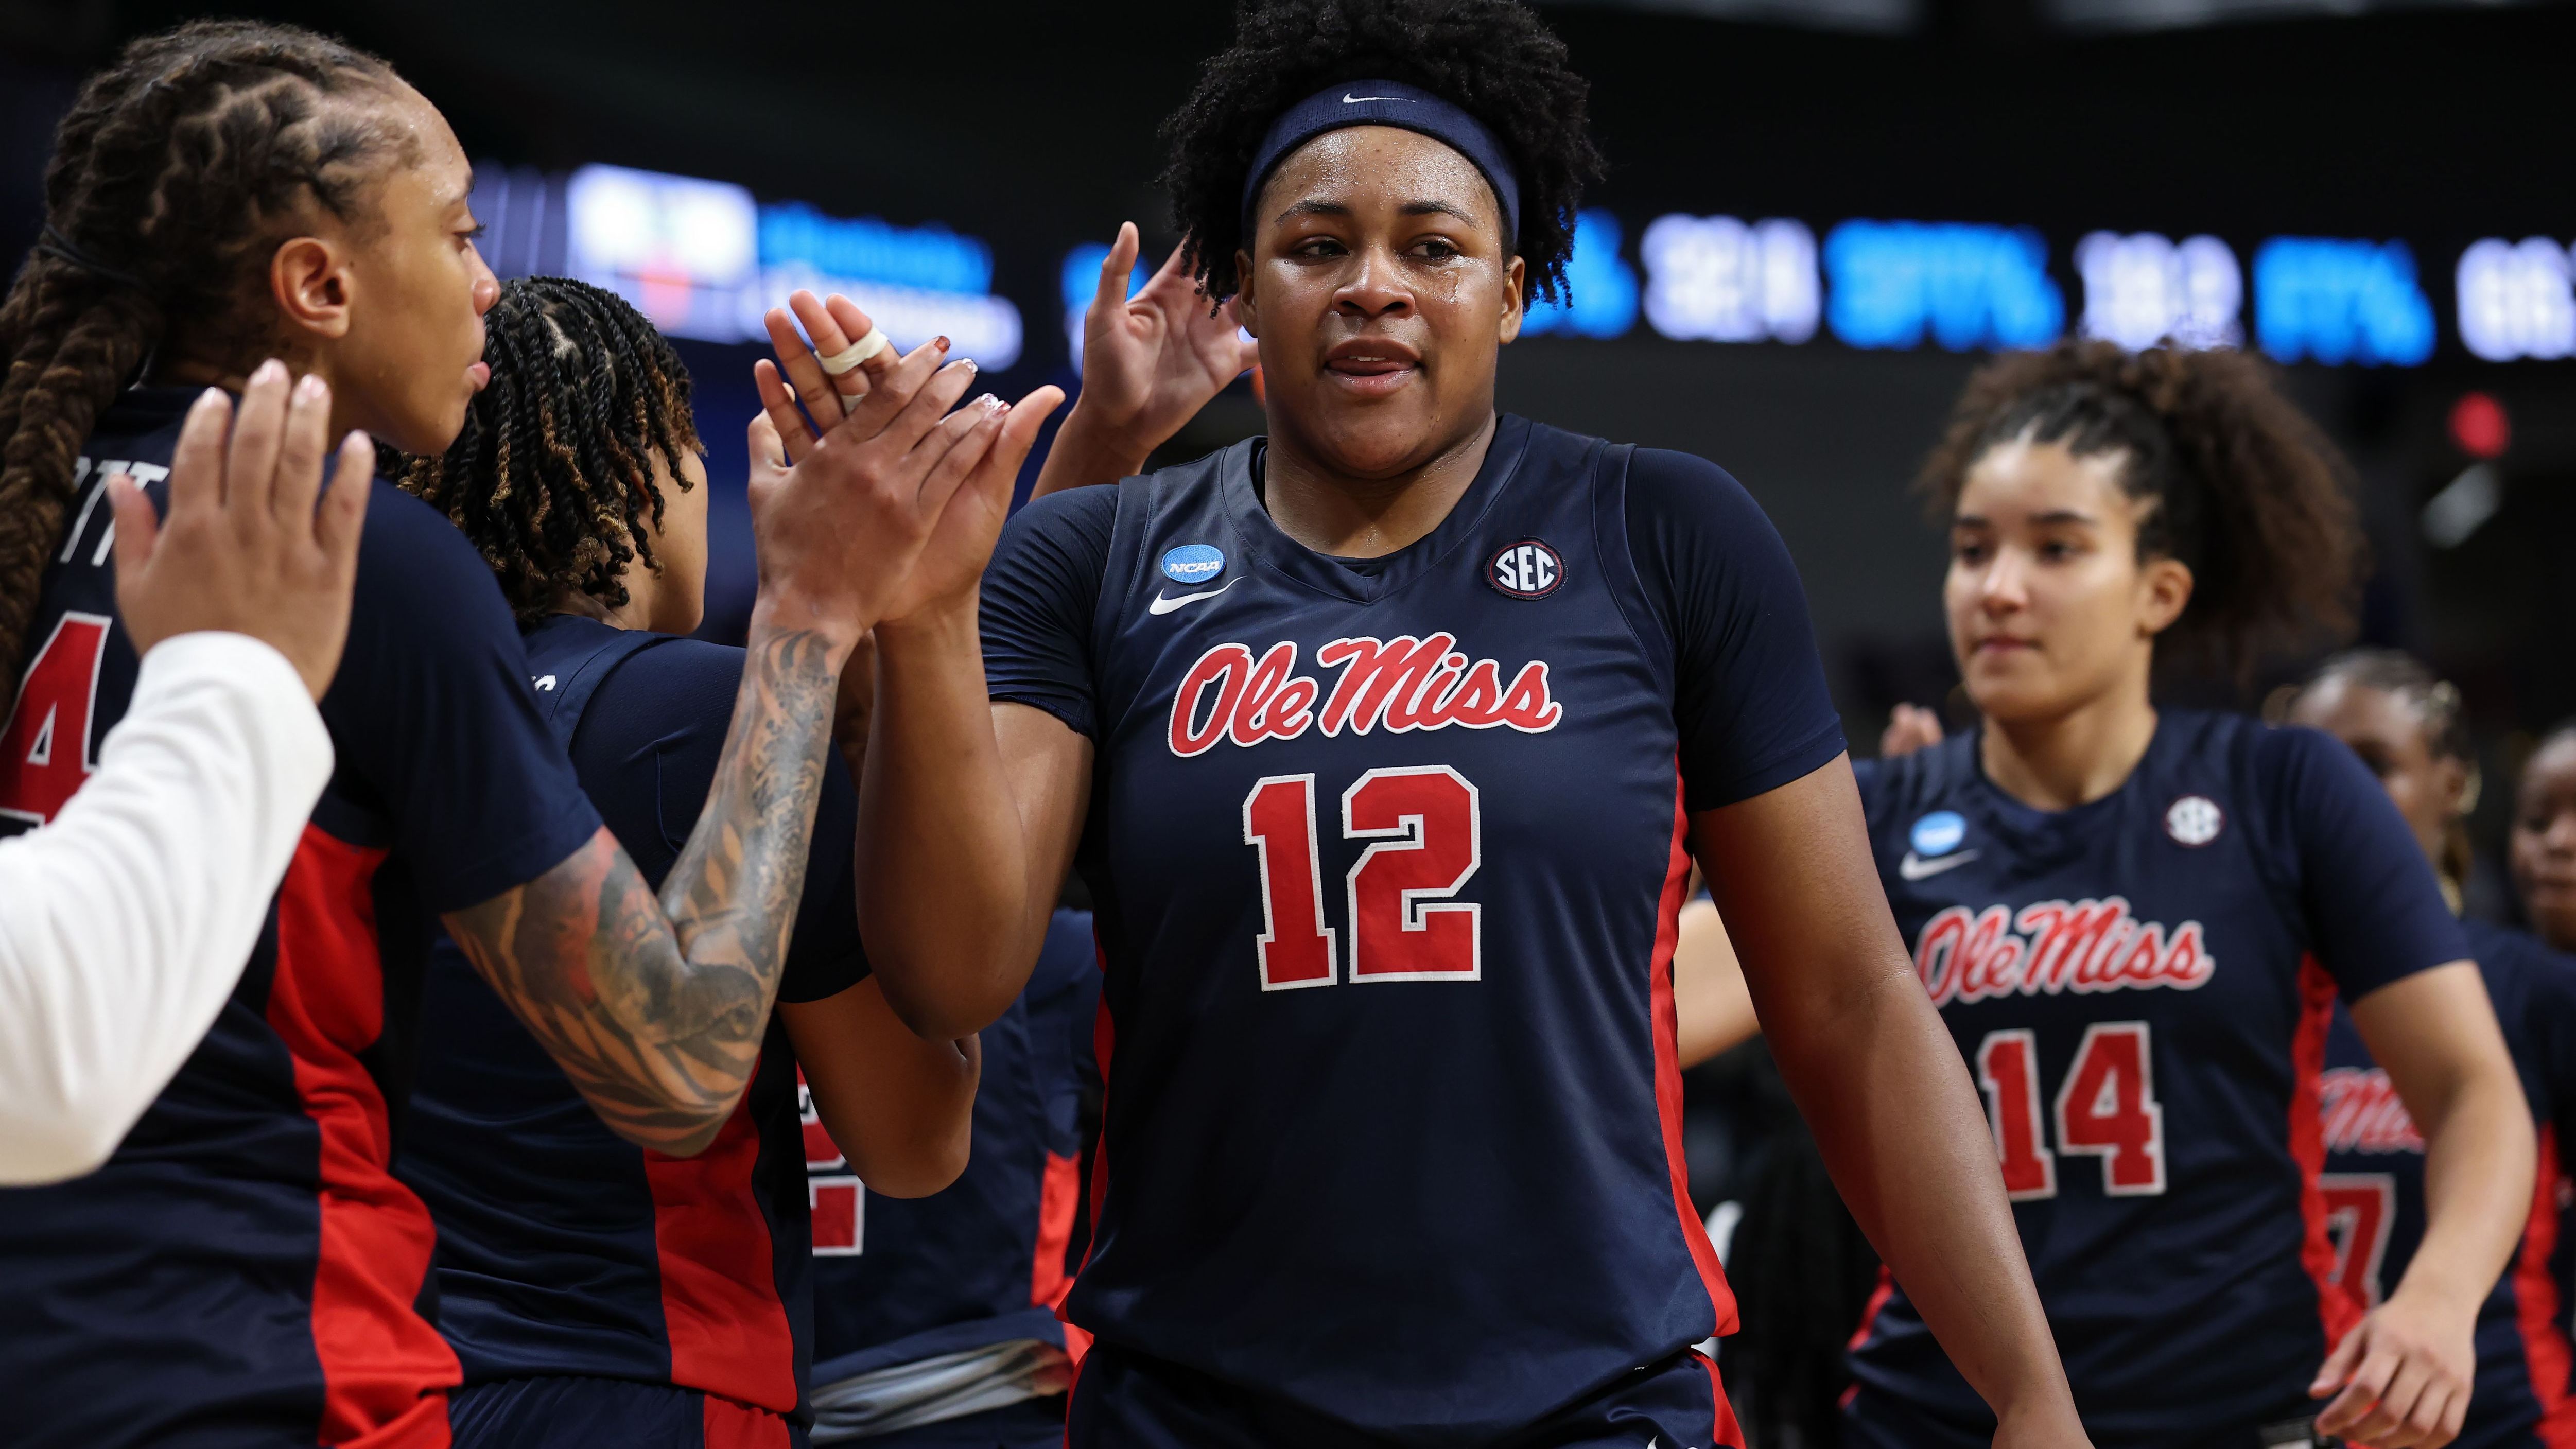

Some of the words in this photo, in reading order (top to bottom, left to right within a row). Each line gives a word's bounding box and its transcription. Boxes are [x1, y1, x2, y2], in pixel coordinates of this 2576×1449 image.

[1169, 561, 1221, 574] NCAA
[1495, 546, 1555, 591] SEC
[1167, 641, 1319, 758] Ole
[1316, 631, 1563, 738] Miss
[1242, 764, 1482, 991] 12
[1913, 904, 2025, 1009] Ole
[2014, 895, 2216, 994] Miss
[1976, 1021, 2166, 1201] 14
